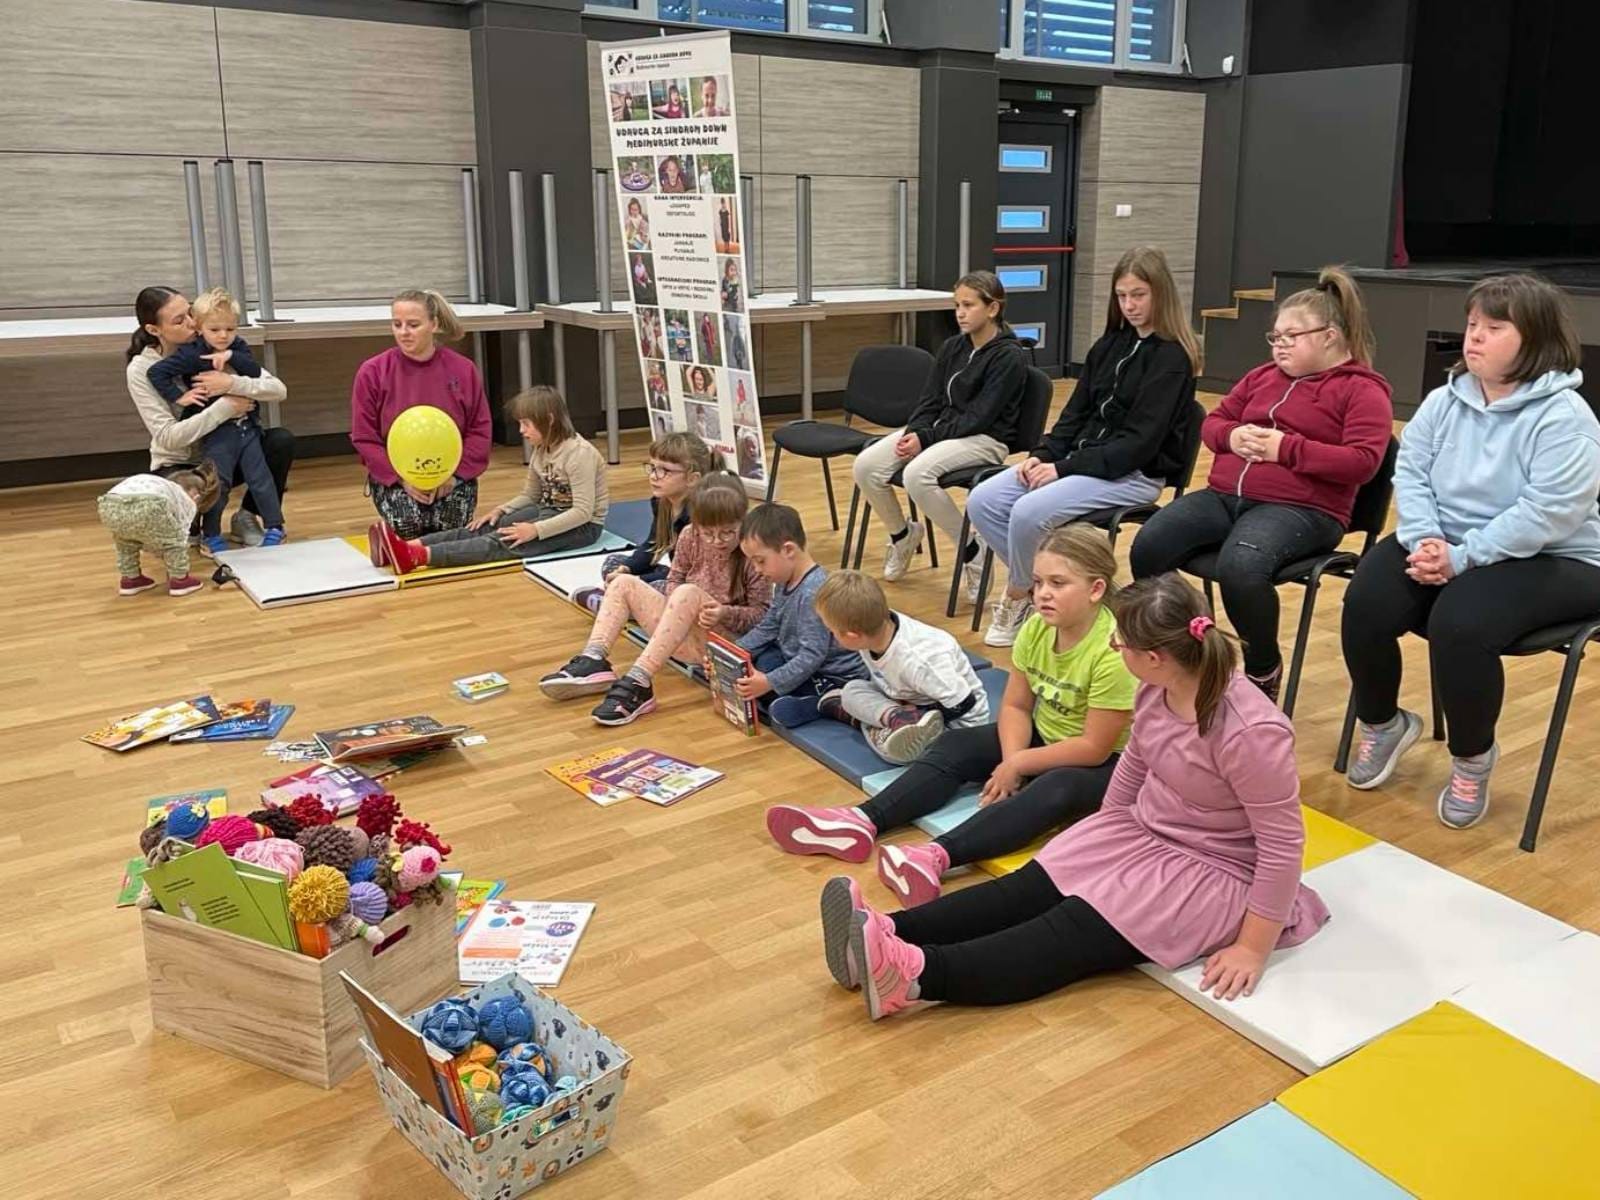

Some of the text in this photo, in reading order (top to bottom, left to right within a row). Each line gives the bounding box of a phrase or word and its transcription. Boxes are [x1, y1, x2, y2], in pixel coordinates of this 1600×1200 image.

[651, 126, 664, 135] ZA
[664, 124, 701, 134] SINDROM
[703, 123, 727, 133] DOWN
